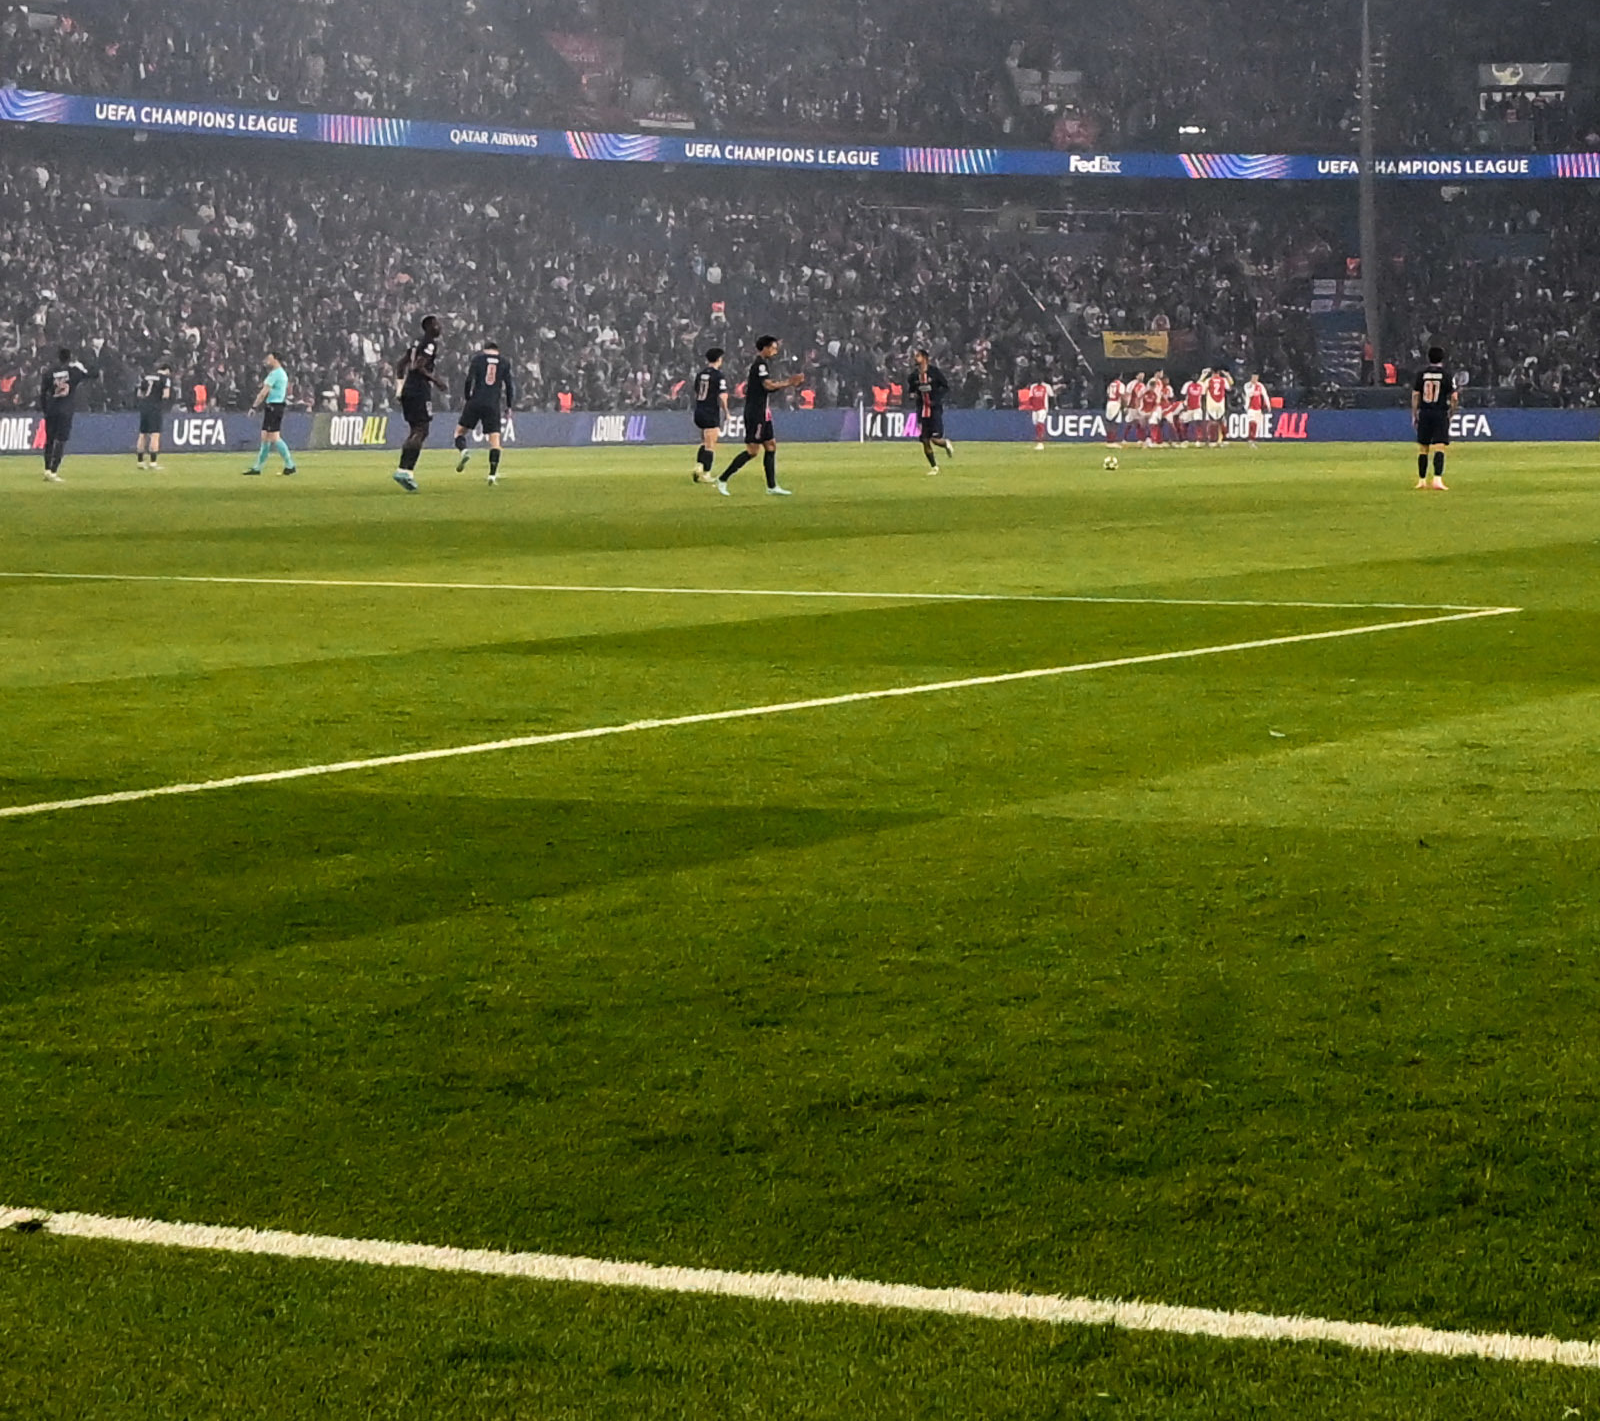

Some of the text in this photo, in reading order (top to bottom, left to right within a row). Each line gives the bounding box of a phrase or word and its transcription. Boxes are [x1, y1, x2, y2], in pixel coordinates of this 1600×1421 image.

[95, 103, 298, 134] UEFA CHAMPIONS LEAGUE
[450, 129, 538, 148] QATAR AIRWAYS
[685, 143, 880, 166] UEFA CHAMPIONS LEAGUE
[1069, 155, 1121, 173] FedEx
[1317, 160, 1359, 174] UEFA
[1465, 159, 1529, 174] LEAGUE
[172, 418, 226, 446] UEFA
[626, 415, 647, 441] ALL
[1046, 414, 1107, 437] UEFA
[1274, 412, 1308, 438] ALL
[1448, 414, 1492, 437] EFA
